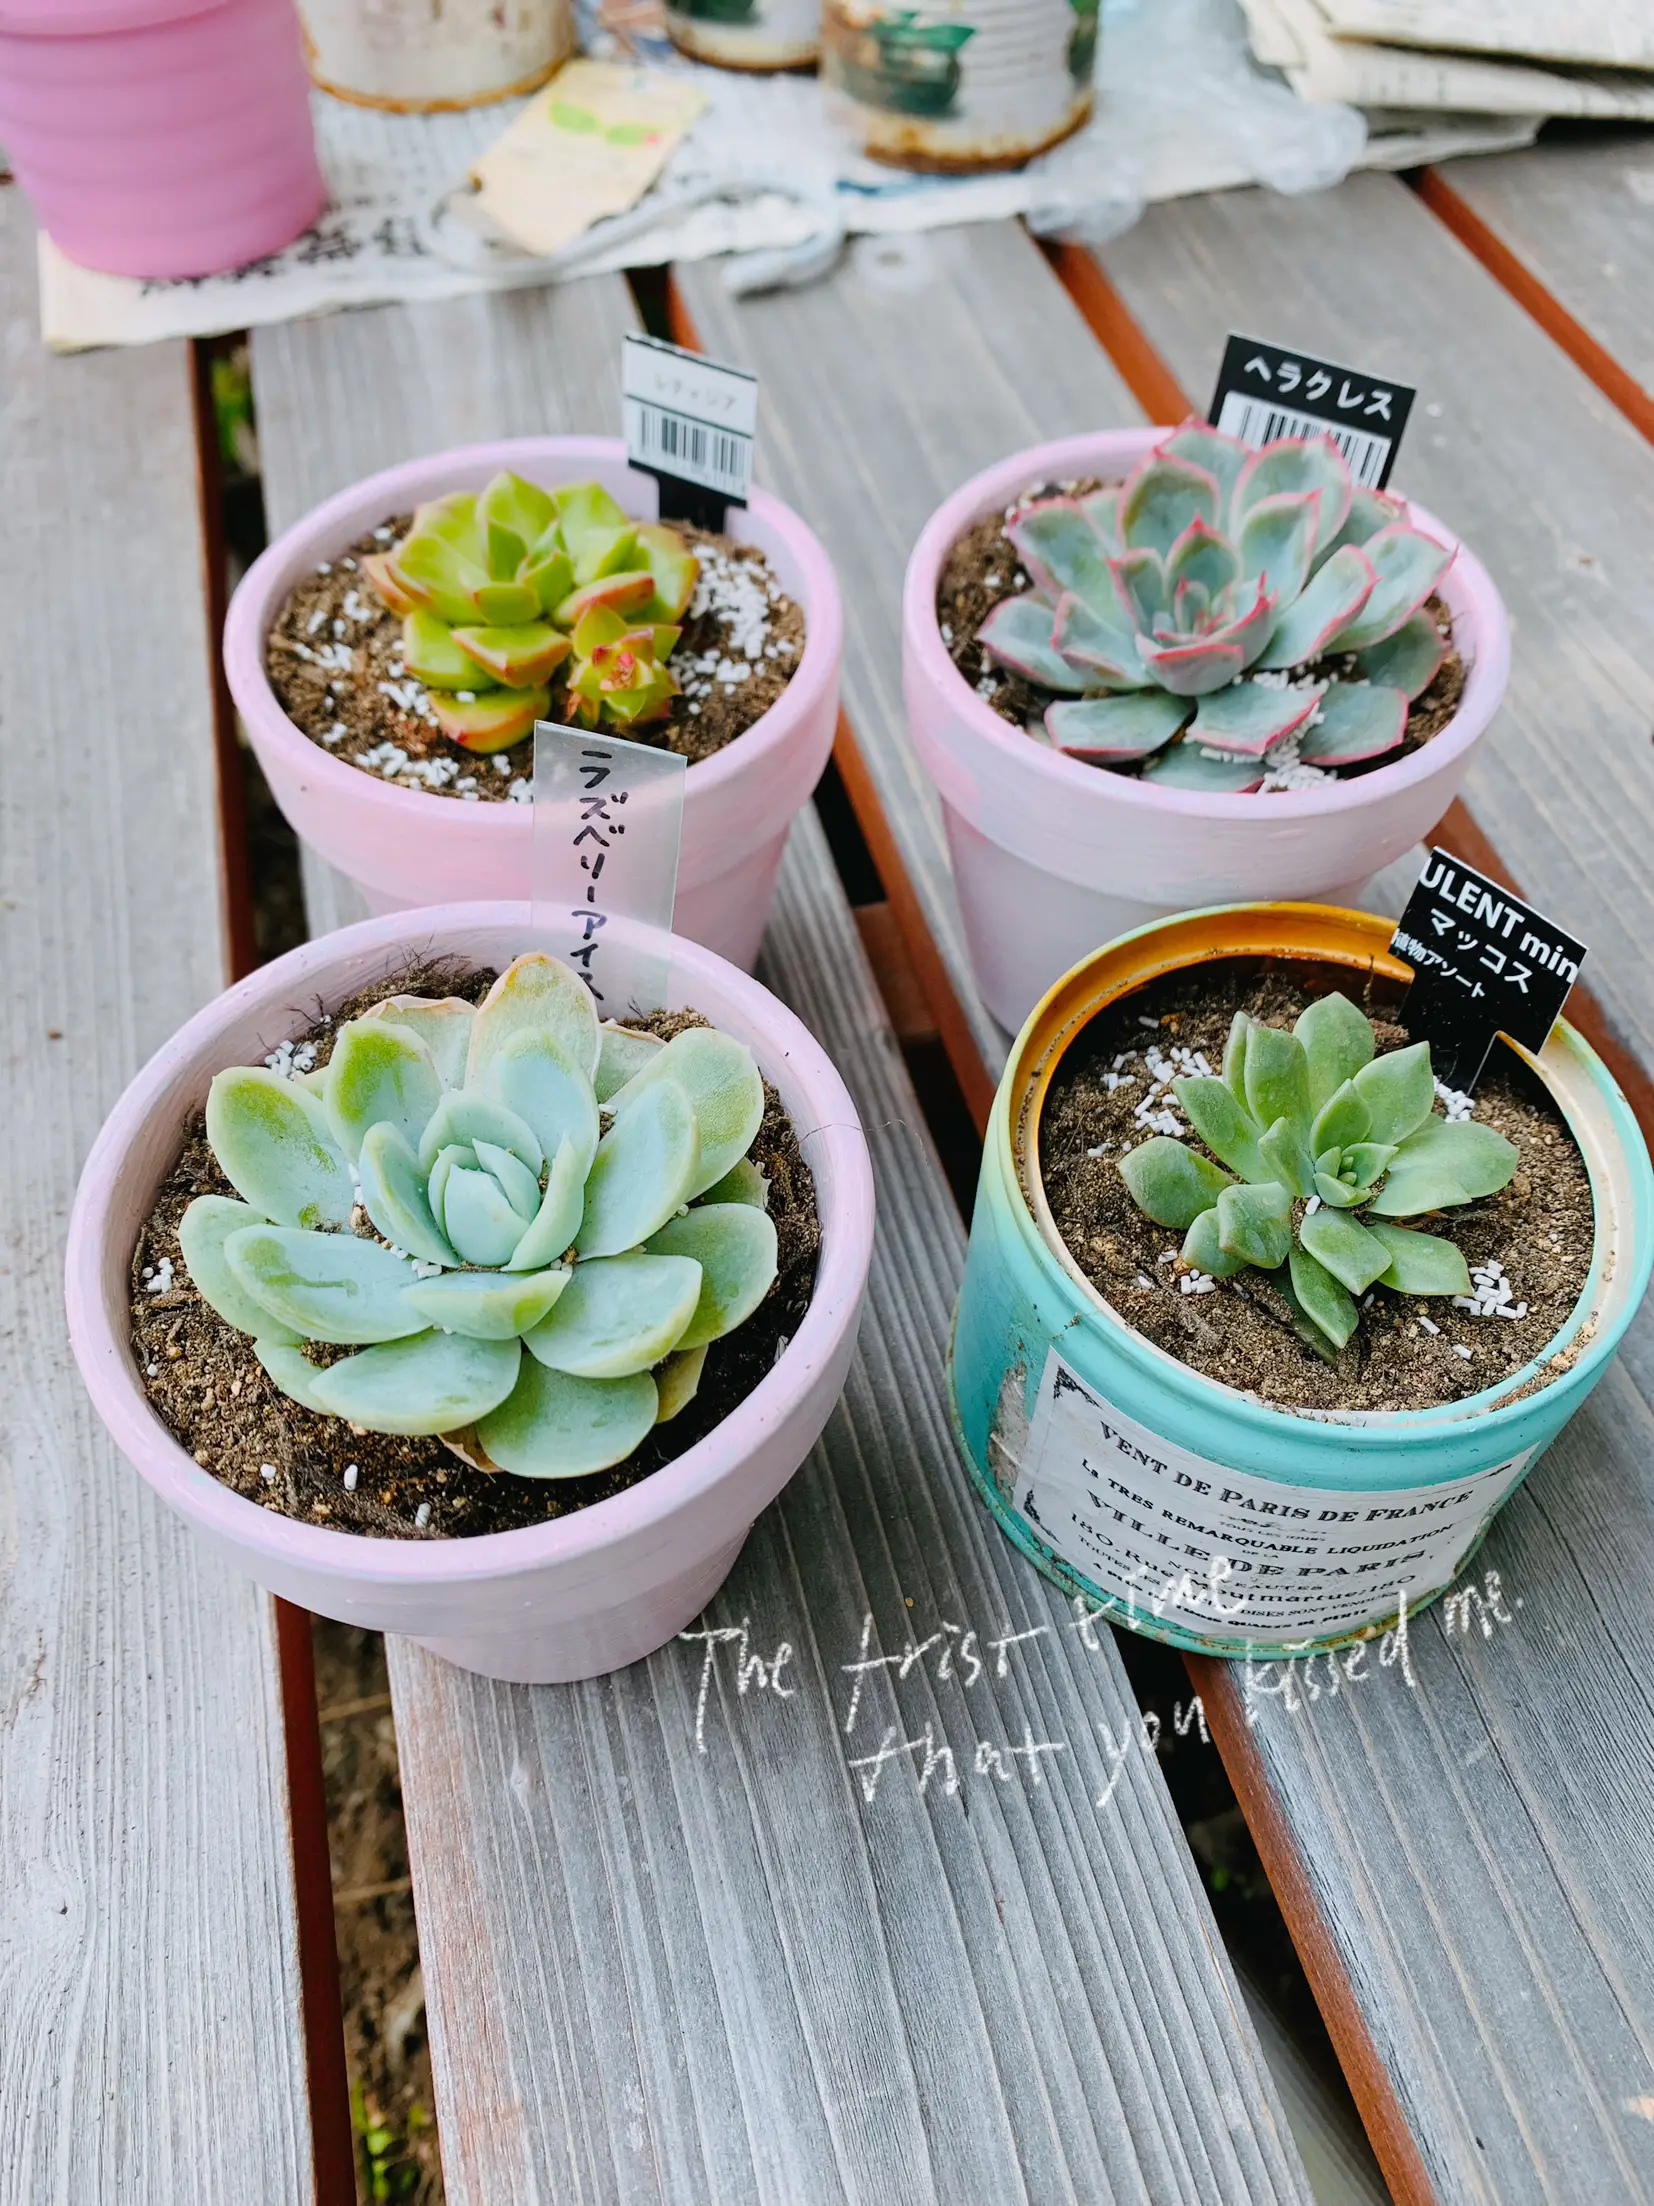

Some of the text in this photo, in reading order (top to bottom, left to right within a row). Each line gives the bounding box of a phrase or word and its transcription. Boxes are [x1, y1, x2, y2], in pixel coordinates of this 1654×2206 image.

[1244, 356, 1394, 421] ヘラクレス
[1431, 908, 1533, 994] マッコス
[1081, 1458, 1454, 1555] La TRES REMARQUABLE LIQUIDATION
[1100, 1420, 1474, 1522] VENT DE PARIS DE FRANCE
[1085, 1488, 1211, 1561] VILLE
[1226, 1557, 1285, 1577] DE
